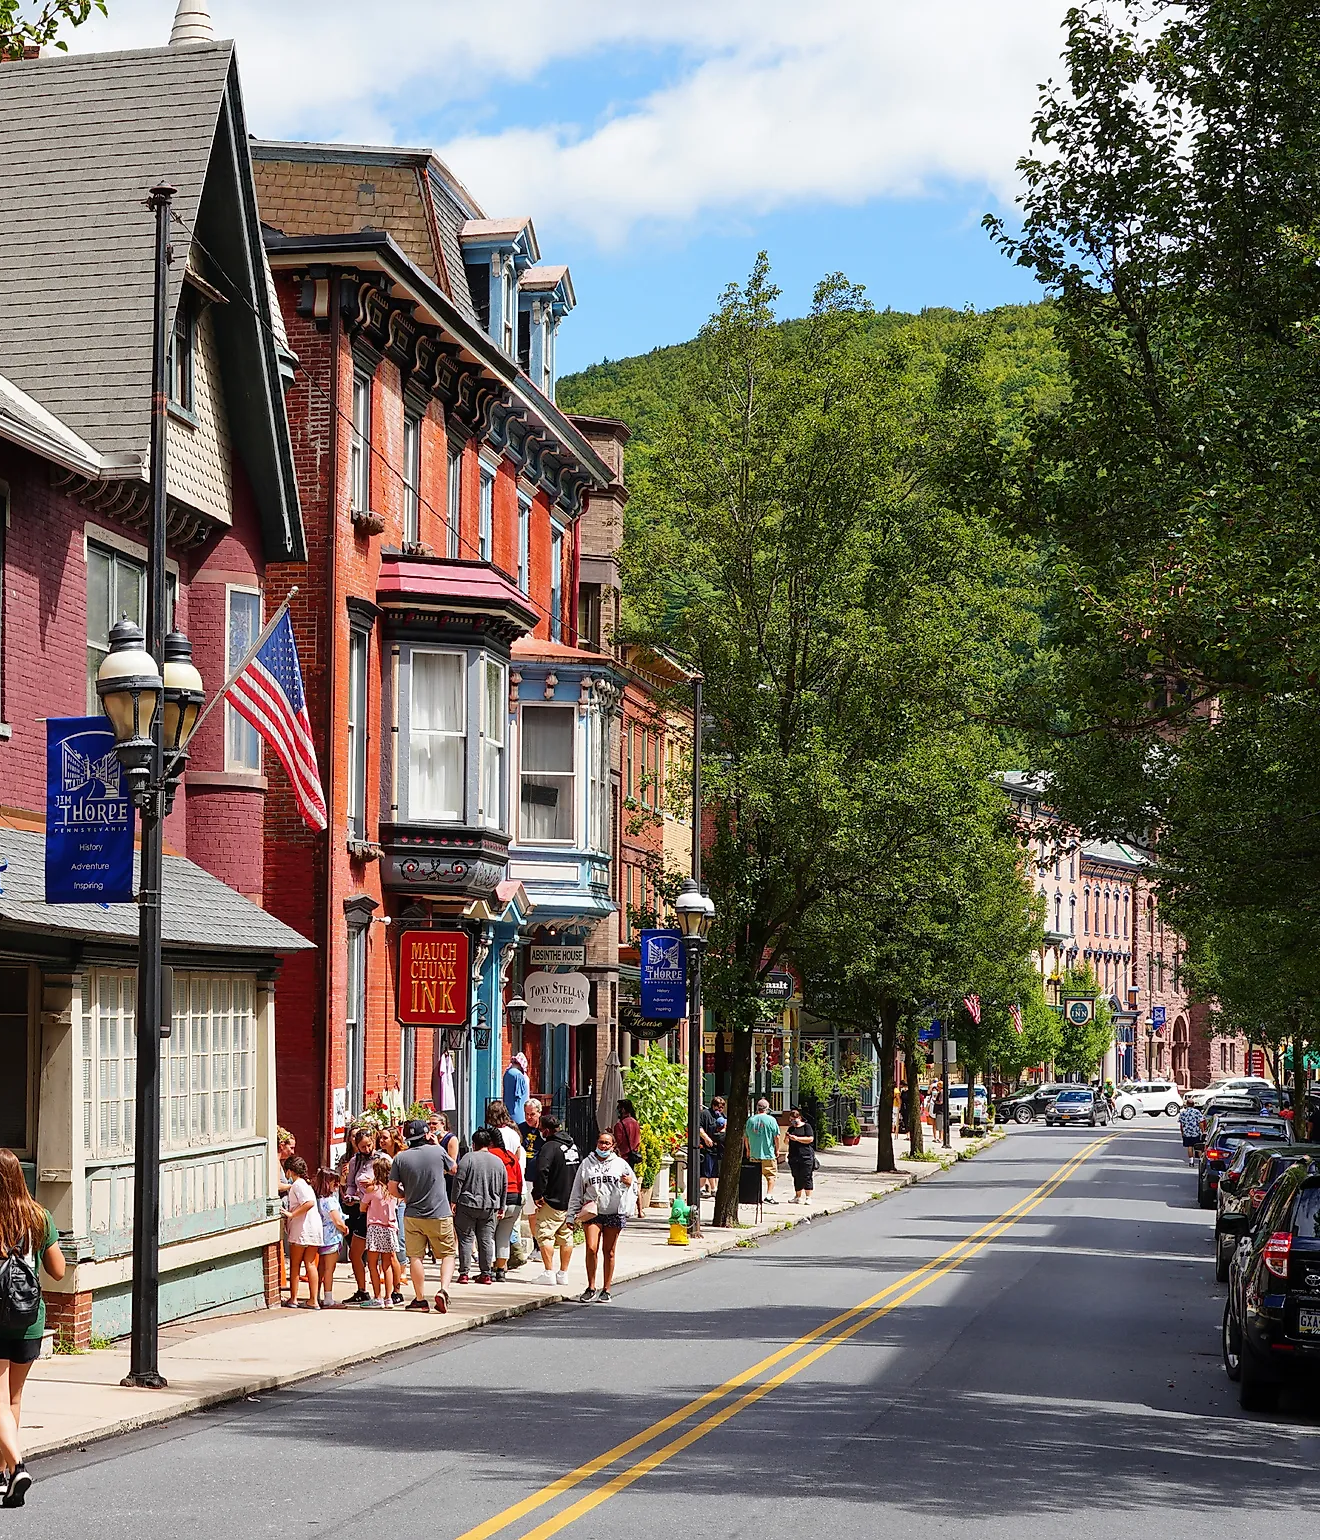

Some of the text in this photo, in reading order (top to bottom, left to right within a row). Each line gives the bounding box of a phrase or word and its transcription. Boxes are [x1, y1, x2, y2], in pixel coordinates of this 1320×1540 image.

[55, 795, 72, 807] JIM
[59, 797, 128, 826] THORPE
[55, 826, 127, 834] PENNSYLVANIA
[79, 843, 103, 852] History
[71, 862, 110, 871] Adventure
[73, 881, 104, 891] Inspiring
[411, 942, 457, 961] MAUCH
[531, 949, 583, 961] ABSINTHE HOUSE
[410, 961, 457, 980] CHUNK
[648, 967, 683, 981] THORPE
[762, 981, 789, 989] ault
[529, 981, 585, 1001] TONY STELLA'S
[410, 980, 457, 1014] INK
[541, 996, 574, 1005] ENCORE
[1071, 1010, 1088, 1018] INN
[630, 1017, 663, 1028] House
